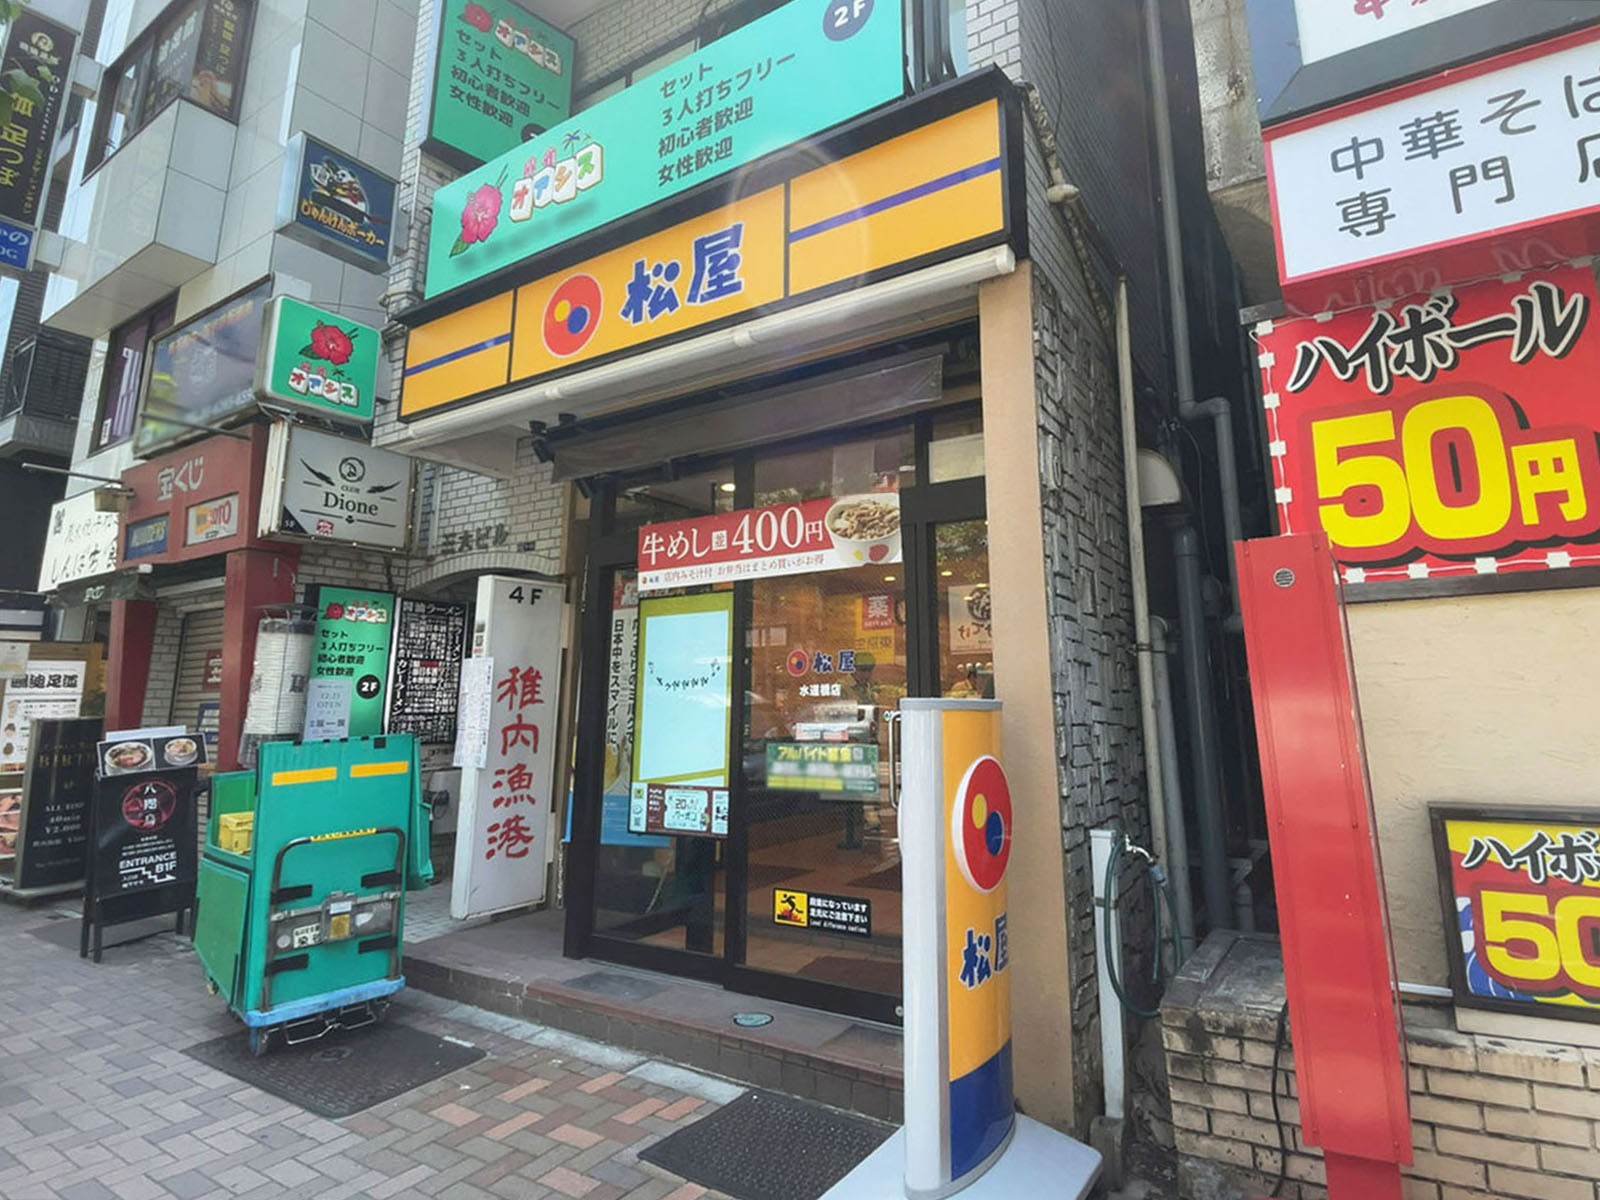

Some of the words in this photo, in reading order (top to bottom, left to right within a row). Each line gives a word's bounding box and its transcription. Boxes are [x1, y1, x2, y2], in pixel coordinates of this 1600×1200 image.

[833, 0, 866, 28] 2F
[456, 29, 502, 61] セット
[496, 21, 561, 71] オアシス
[451, 64, 531, 118] 初心者歓迎
[660, 63, 713, 99] セット
[449, 84, 514, 128] 女性歓迎
[658, 96, 754, 159] 初心者歓迎
[658, 135, 733, 187] 女性歓迎
[511, 147, 600, 218] オアシス
[619, 220, 746, 326] 松屋
[1285, 281, 1585, 394] ハイボール
[289, 369, 356, 403] オアシス
[157, 456, 204, 502] 宝くじ
[1311, 395, 1588, 549] 50円
[323, 491, 379, 516] Dione
[642, 531, 711, 566] 牛めし
[508, 586, 543, 606] 4F
[321, 629, 348, 638] セット
[317, 654, 365, 665] 初心者歓迎
[317, 666, 354, 676] 女性歓迎
[811, 649, 856, 675] 松屋
[361, 682, 378, 691] 2F
[485, 666, 545, 860] 稚内漁港
[119, 851, 177, 869] ENTRANCE
[155, 860, 177, 873] B1F
